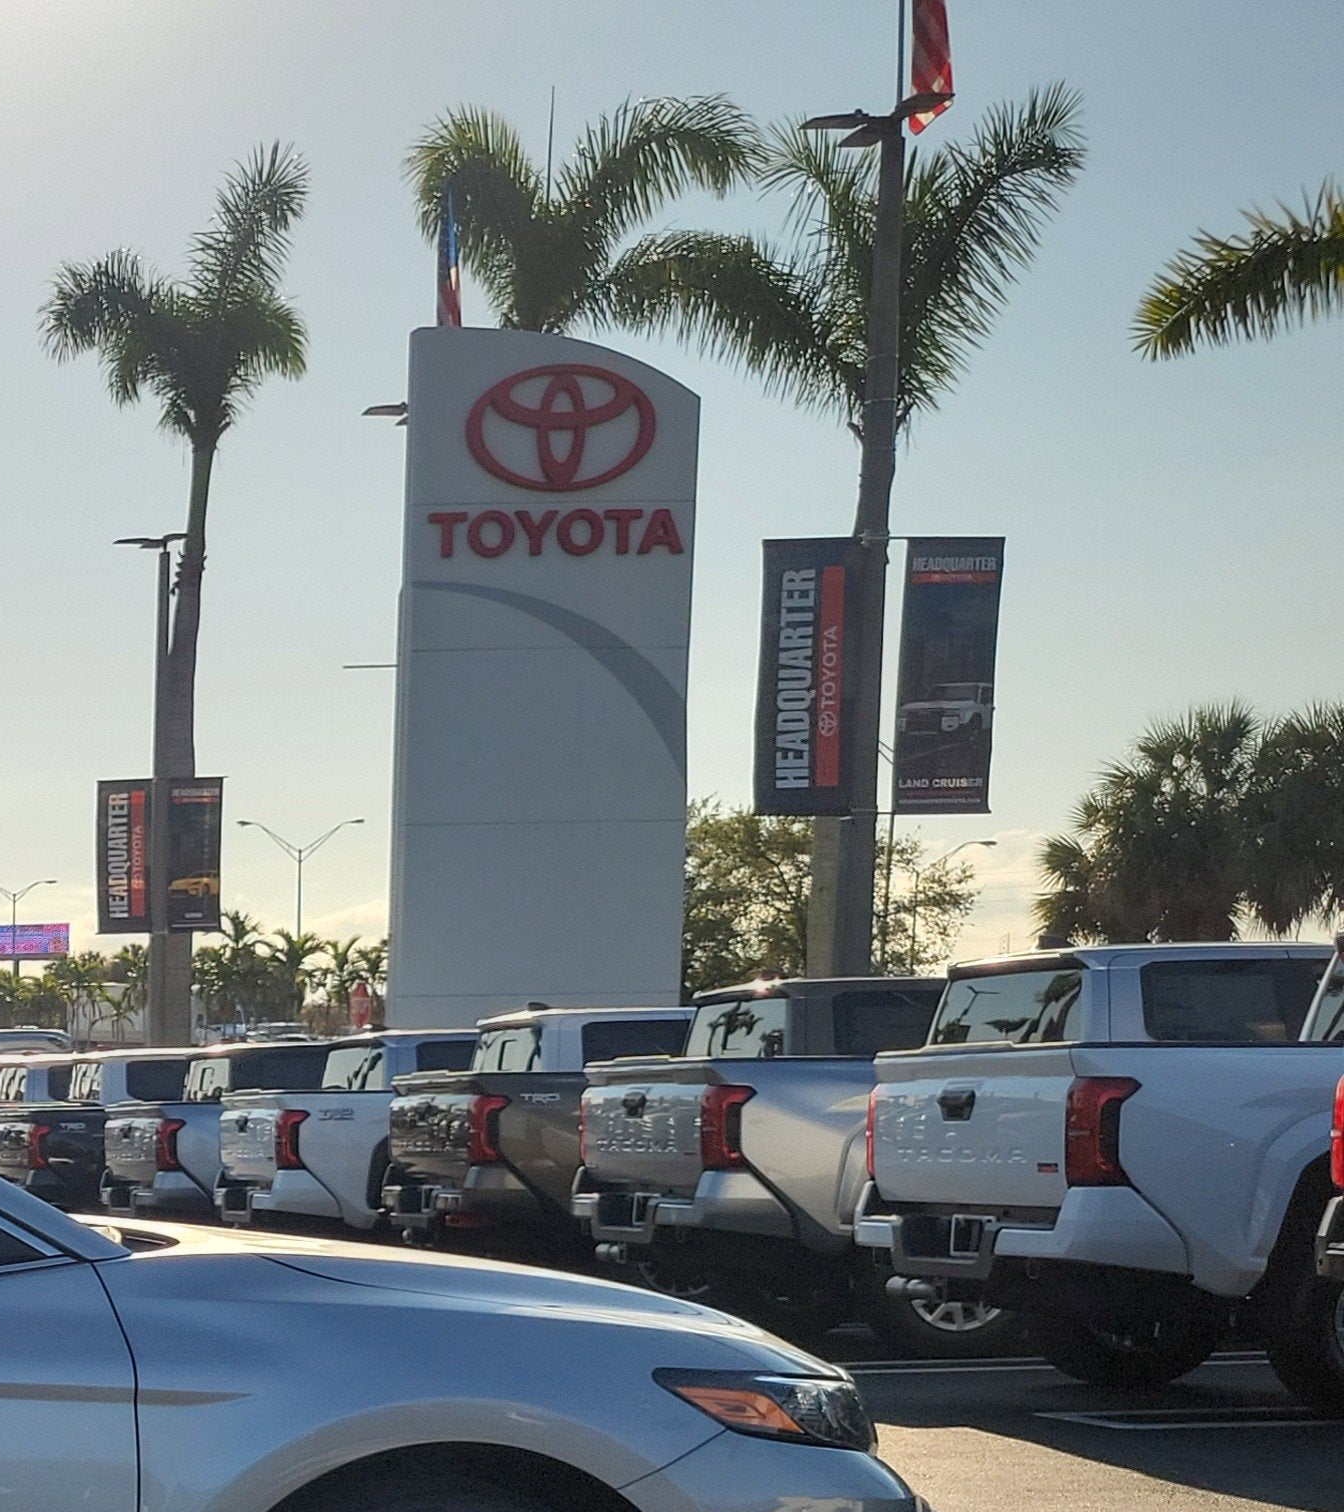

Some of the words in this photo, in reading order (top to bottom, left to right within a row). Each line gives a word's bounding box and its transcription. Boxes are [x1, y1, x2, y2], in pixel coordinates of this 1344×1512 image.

[428, 508, 684, 558] TOYOTA
[913, 557, 997, 572] HEADQUARTER
[775, 568, 816, 789] HEADQUARTER
[820, 626, 838, 708] TOYOTA
[899, 779, 929, 788] LAND
[933, 778, 983, 788] CRUISER
[108, 793, 130, 918] HEADQUARTER
[132, 826, 143, 874] TOYOTA
[597, 1140, 678, 1153] TACOMA
[897, 1149, 1027, 1163] TACOMA
